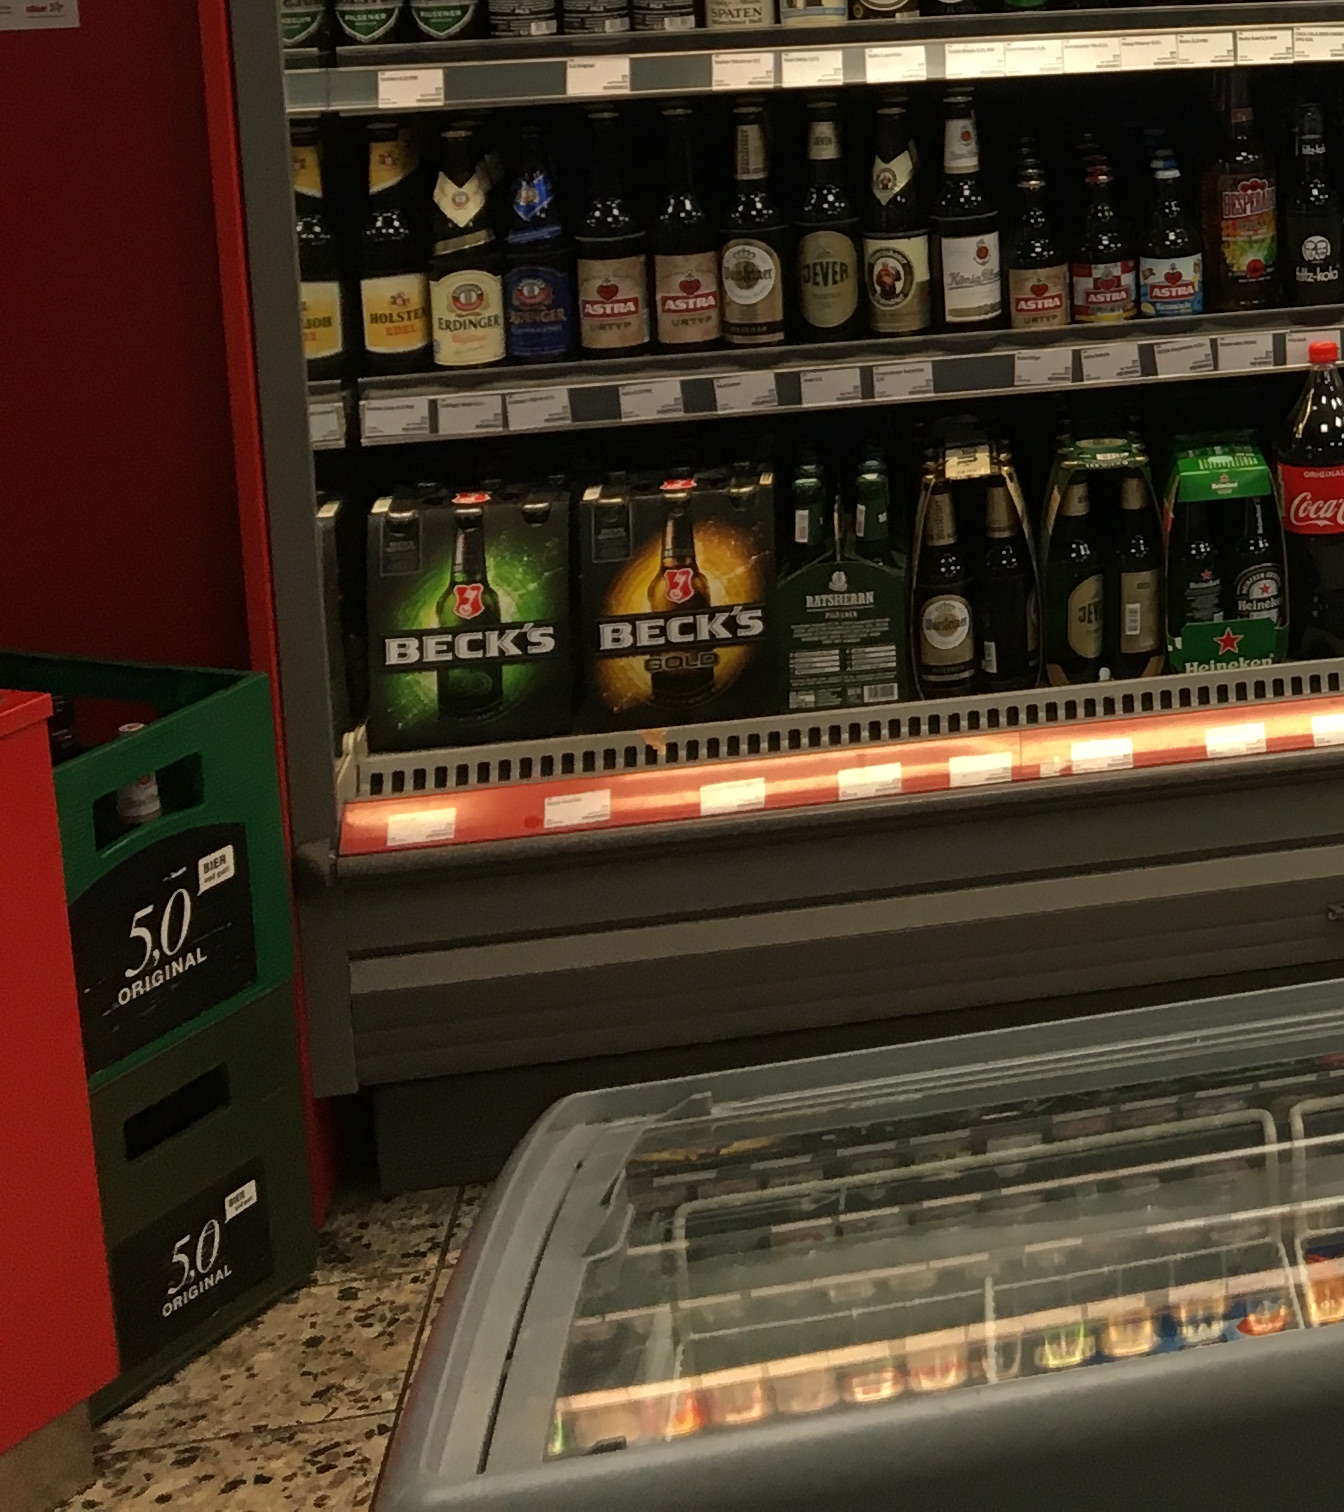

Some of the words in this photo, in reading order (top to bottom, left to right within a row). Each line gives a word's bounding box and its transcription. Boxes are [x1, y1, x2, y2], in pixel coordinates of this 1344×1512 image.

[711, 6, 763, 21] SPATEN
[803, 263, 848, 287] JEVER
[1087, 290, 1128, 304] ASTRA
[1151, 284, 1195, 298] ASTRA
[584, 301, 635, 316] ASTRA
[663, 295, 717, 313] ASTRA
[1016, 296, 1061, 312] ASTRA
[437, 314, 500, 332] ERDINGER
[806, 590, 876, 610] RATSHERRN
[600, 605, 764, 651] BECK'S
[384, 623, 556, 666] BECK'S
[644, 650, 720, 673] GOLD
[125, 887, 192, 979] 5,0
[117, 947, 208, 1007] ORIGINAL
[168, 1218, 221, 1296] 5,0
[161, 1264, 233, 1319] ORIGINAL
